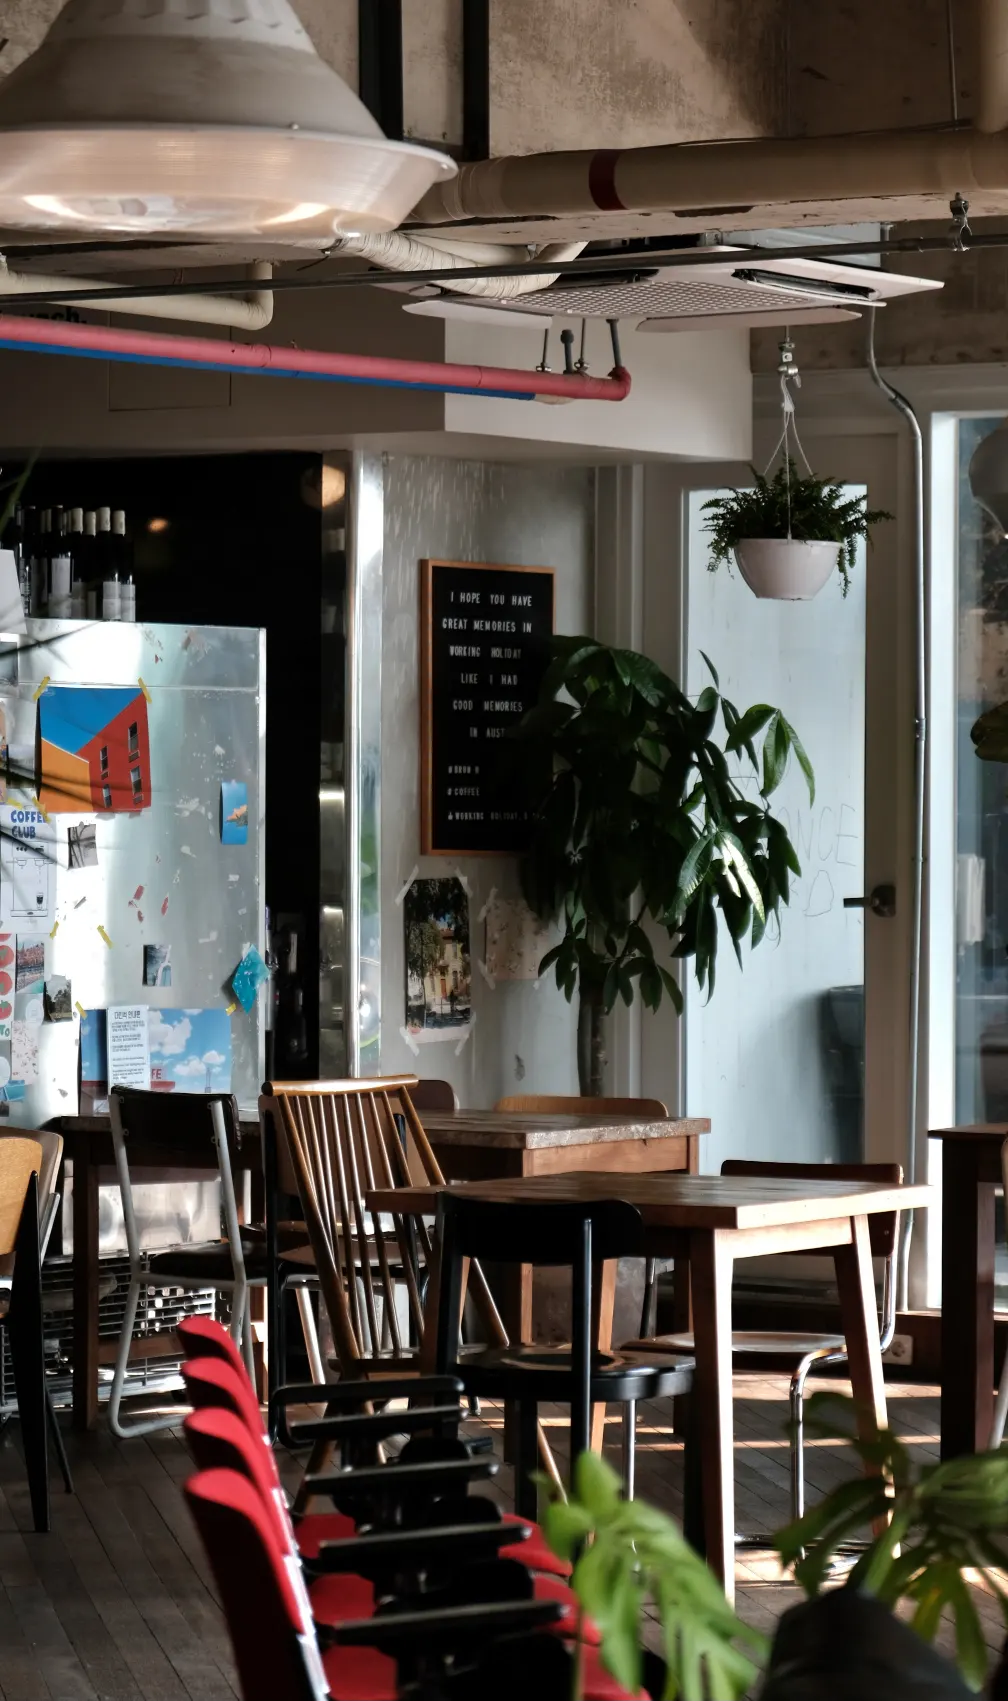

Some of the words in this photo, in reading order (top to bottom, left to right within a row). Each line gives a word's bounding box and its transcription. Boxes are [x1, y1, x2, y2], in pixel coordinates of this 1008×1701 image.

[450, 591, 454, 602] I
[459, 592, 480, 604] HOPE
[490, 593, 505, 605] YOU
[511, 594, 532, 607] HAVE
[442, 617, 468, 630] GREAT
[473, 619, 516, 633] MEMORIES
[522, 621, 532, 633] IN
[449, 645, 481, 658] WORKING
[490, 646, 522, 659] HOLIDAY
[460, 672, 478, 684] LIKE
[500, 673, 518, 686] HAD
[452, 699, 473, 711] GOOD
[483, 700, 523, 712] MEMORIES
[11, 825, 36, 839] CLUB
